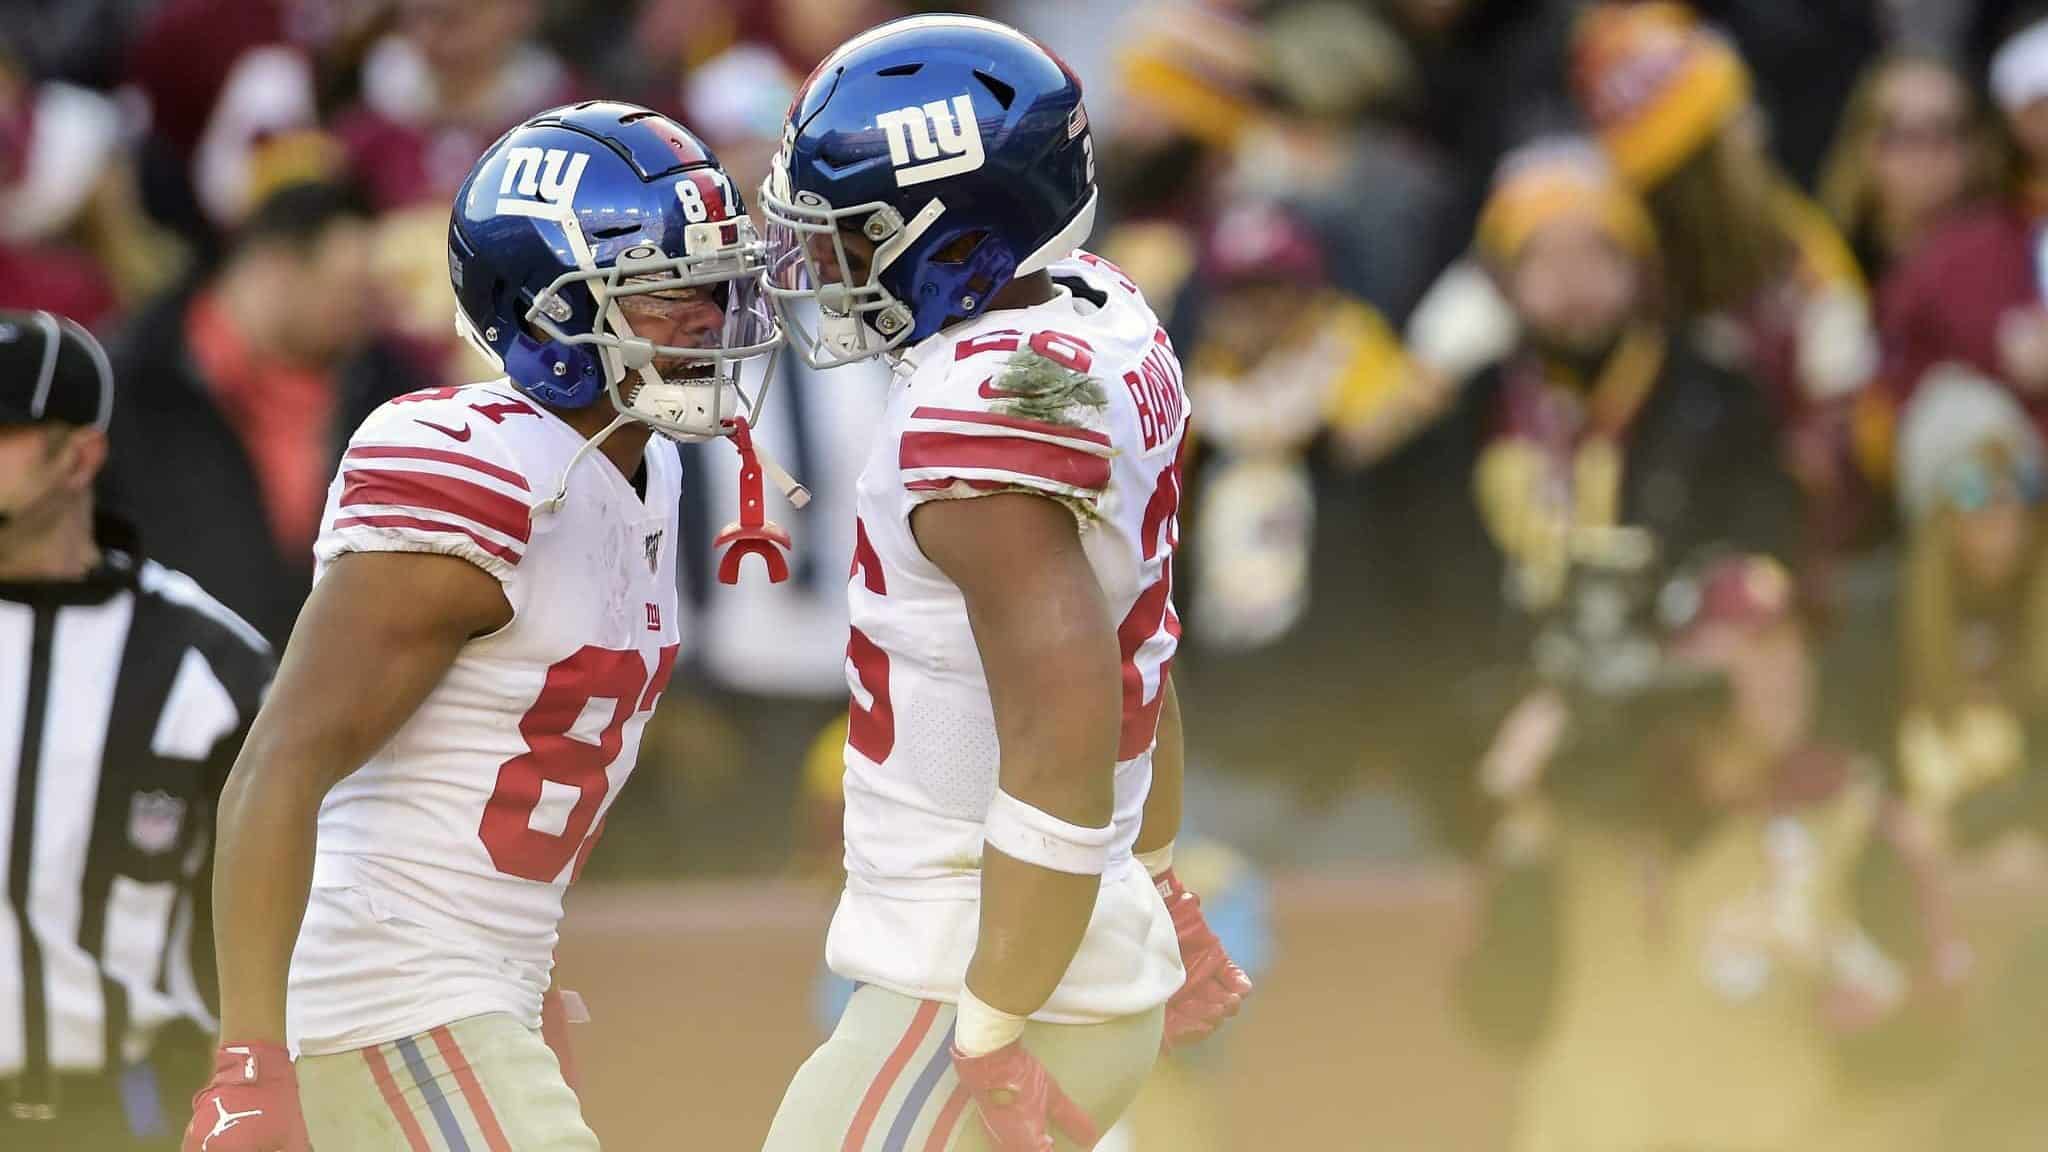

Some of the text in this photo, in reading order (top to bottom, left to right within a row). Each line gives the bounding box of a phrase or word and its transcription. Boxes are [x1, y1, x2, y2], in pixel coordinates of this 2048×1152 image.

[877, 94, 984, 187] ny
[496, 147, 590, 220] ny
[675, 168, 737, 222] 87
